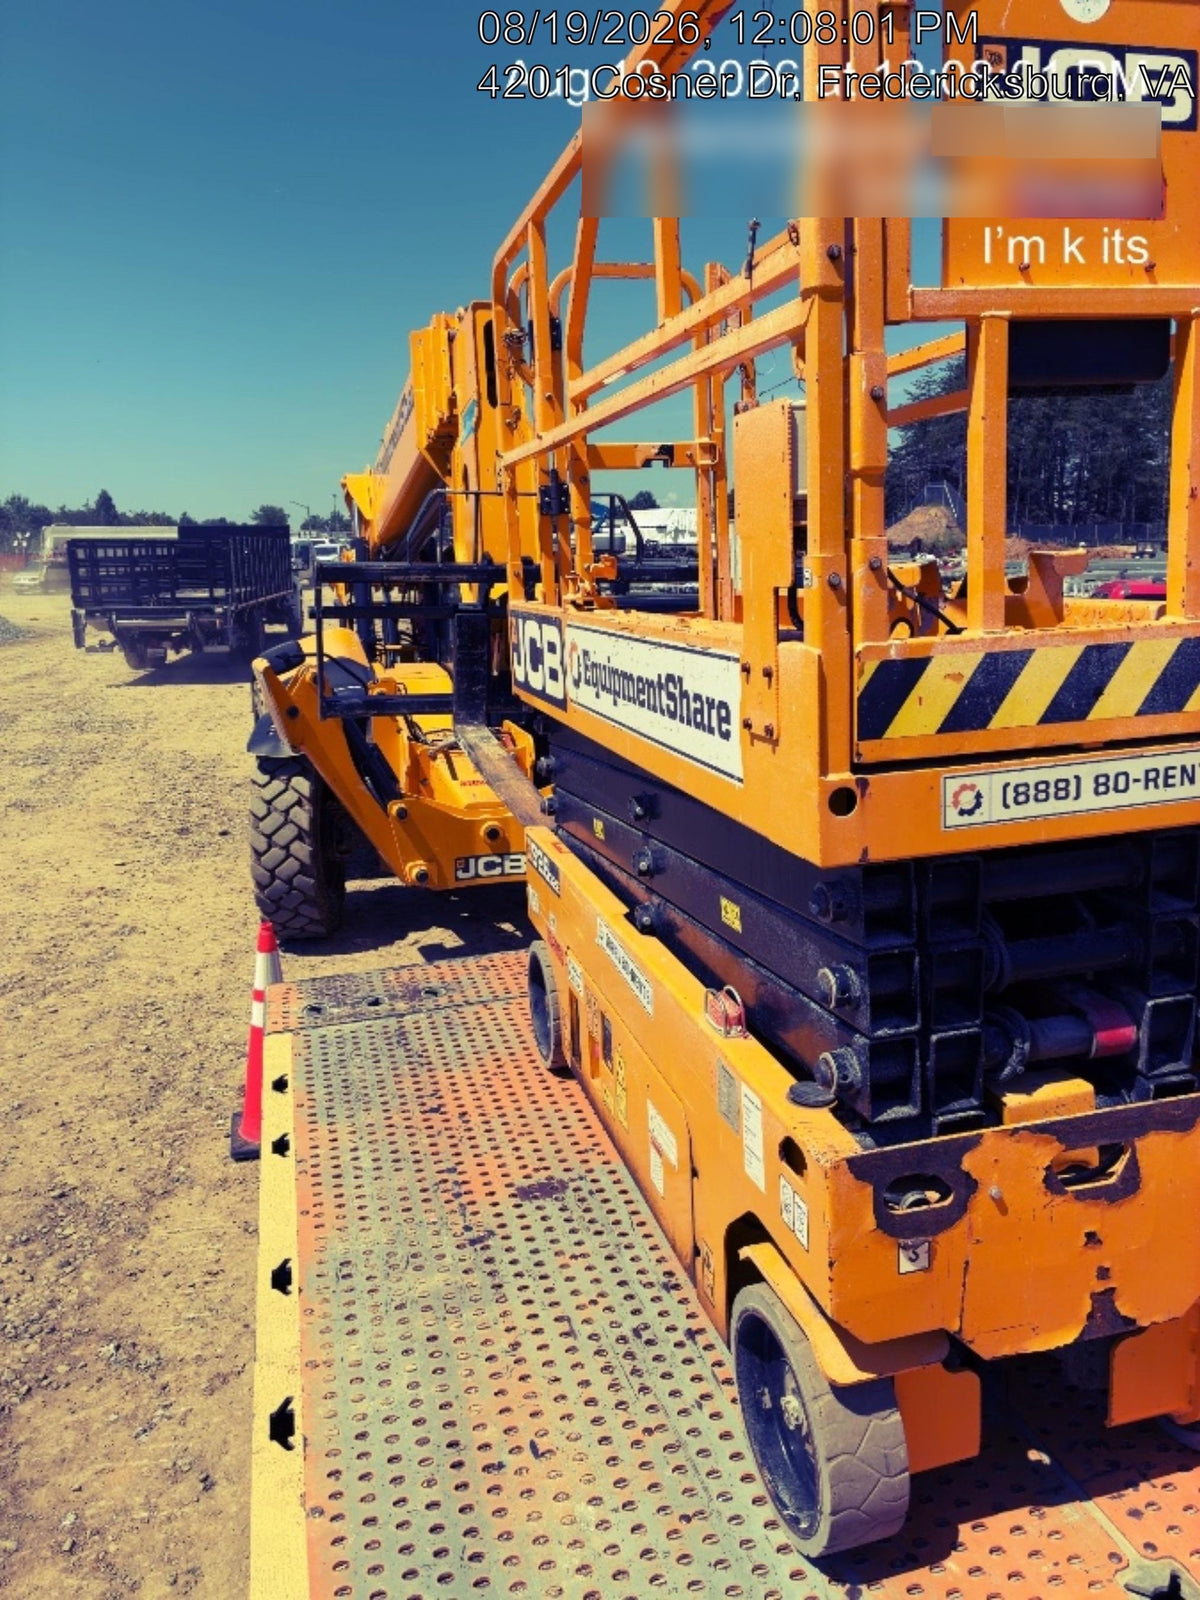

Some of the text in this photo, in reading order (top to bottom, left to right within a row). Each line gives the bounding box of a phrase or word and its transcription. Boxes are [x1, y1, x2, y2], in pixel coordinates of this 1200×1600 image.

[513, 618, 564, 699] JCB
[583, 649, 732, 742] EquipmentShare
[1002, 762, 1200, 810] (888) 80-REN
[456, 853, 527, 879] JCB
